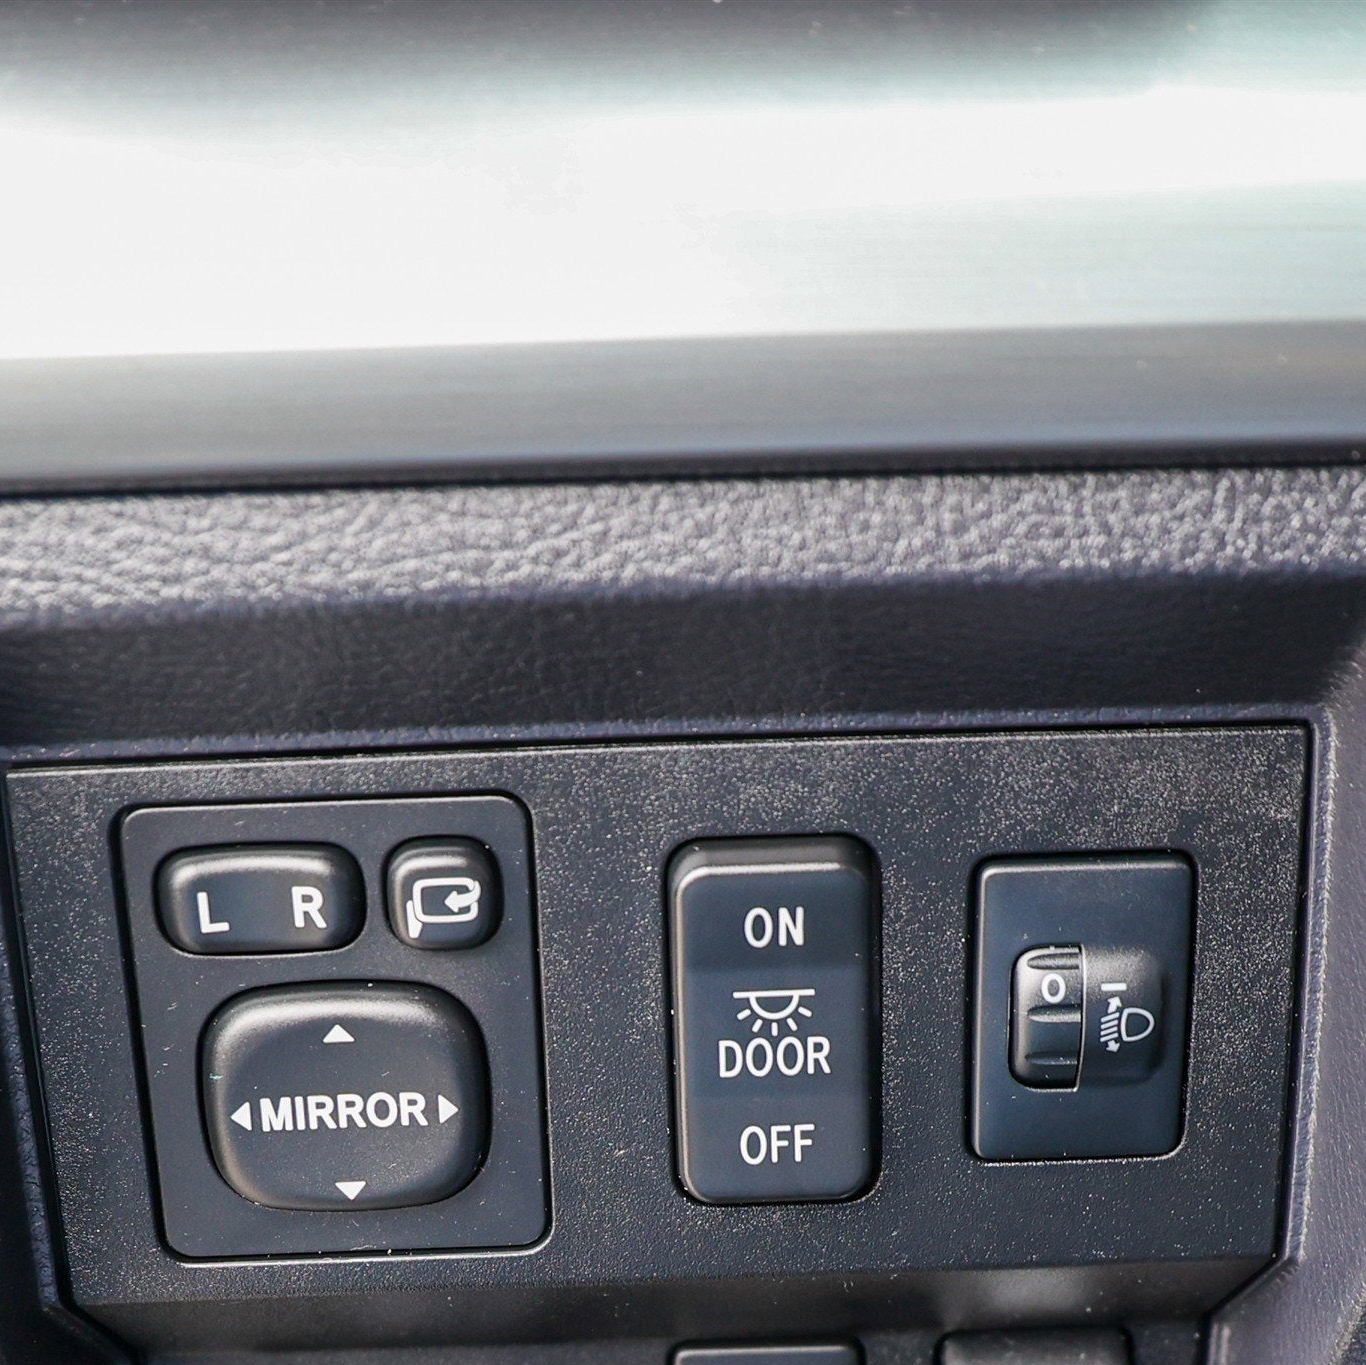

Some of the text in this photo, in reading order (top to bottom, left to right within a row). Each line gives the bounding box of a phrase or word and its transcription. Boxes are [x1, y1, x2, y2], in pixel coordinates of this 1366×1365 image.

[196, 885, 327, 934] L R
[744, 906, 805, 948] ON
[718, 1036, 831, 1078] DOOR
[259, 1091, 429, 1132] MIRROR
[739, 1123, 815, 1165] OFF
